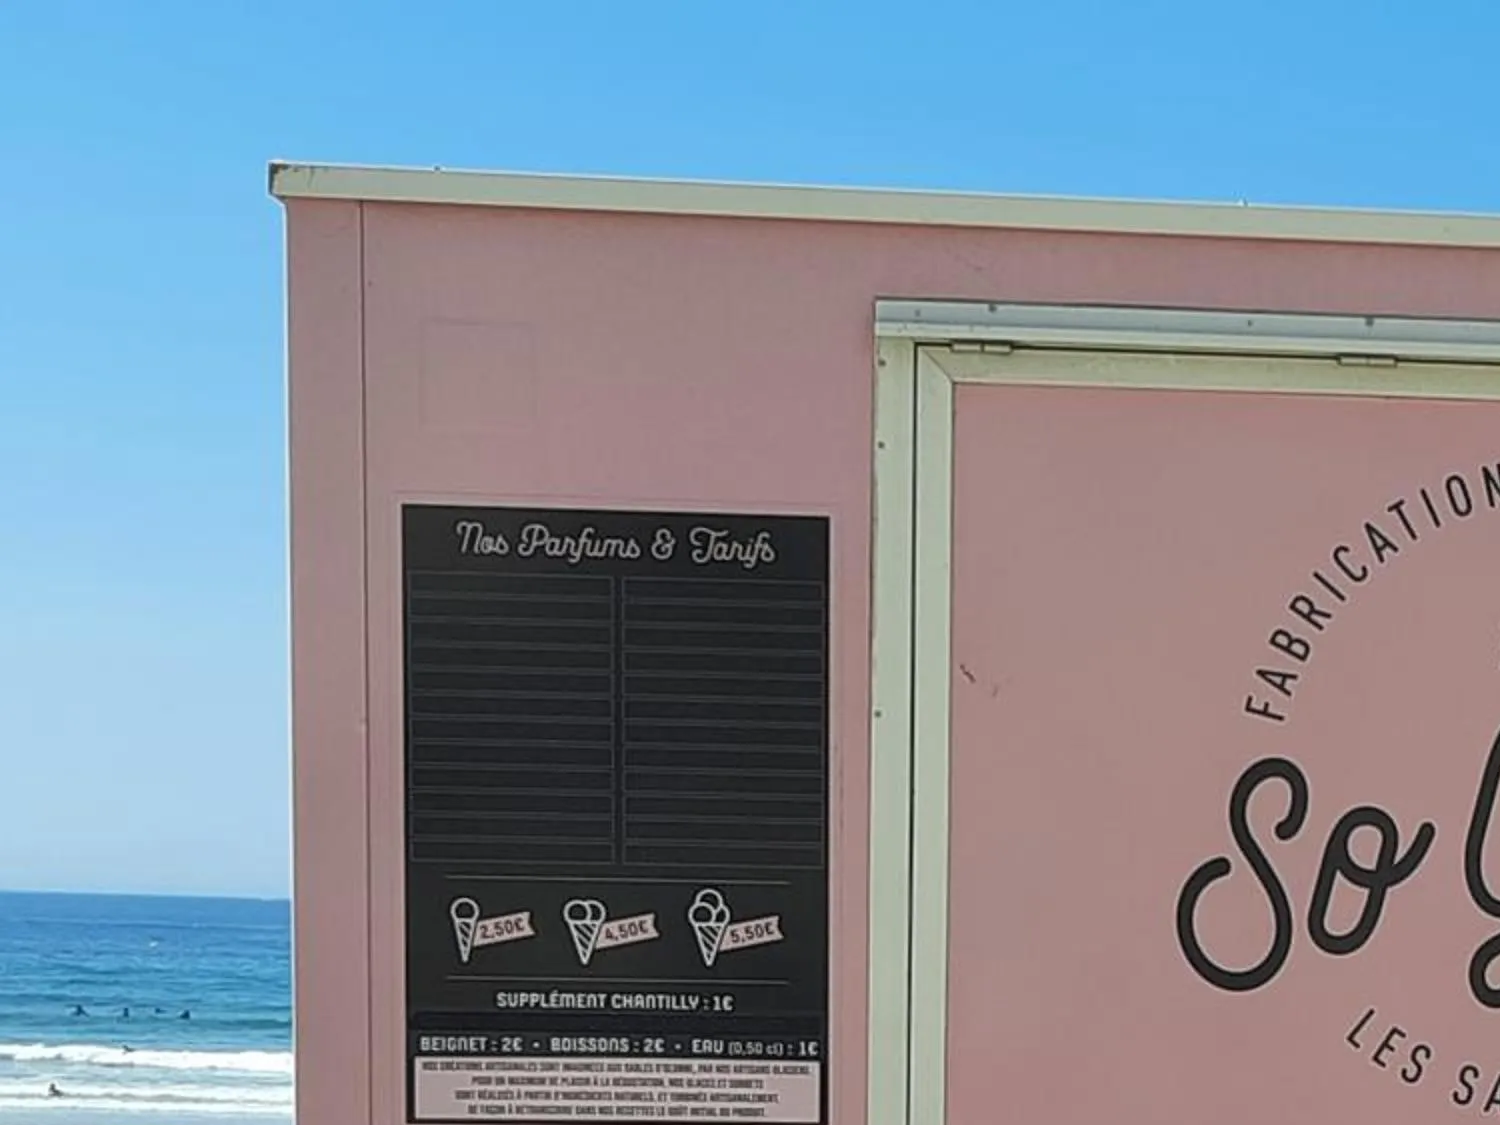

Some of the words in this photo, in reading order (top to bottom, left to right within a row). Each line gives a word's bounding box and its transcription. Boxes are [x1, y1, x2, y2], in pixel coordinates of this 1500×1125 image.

[456, 521, 509, 554] Nos
[517, 523, 641, 563] Parfums
[651, 528, 676, 560] &
[690, 527, 775, 568] Tarifs
[1176, 757, 1436, 993] So
[480, 917, 525, 939] 2,50€
[604, 918, 649, 941] 4,50€
[729, 920, 775, 943] 5,50€
[496, 990, 607, 1008] SUPPLÉMENT
[611, 993, 699, 1010] CHANTILLY
[420, 1037, 488, 1051] BEIGNET
[502, 1037, 523, 1051] 2€
[550, 1037, 629, 1053] BOISSONS
[643, 1038, 665, 1053] 2€
[691, 1039, 724, 1053] EAU
[1346, 1008, 1431, 1084] LES
